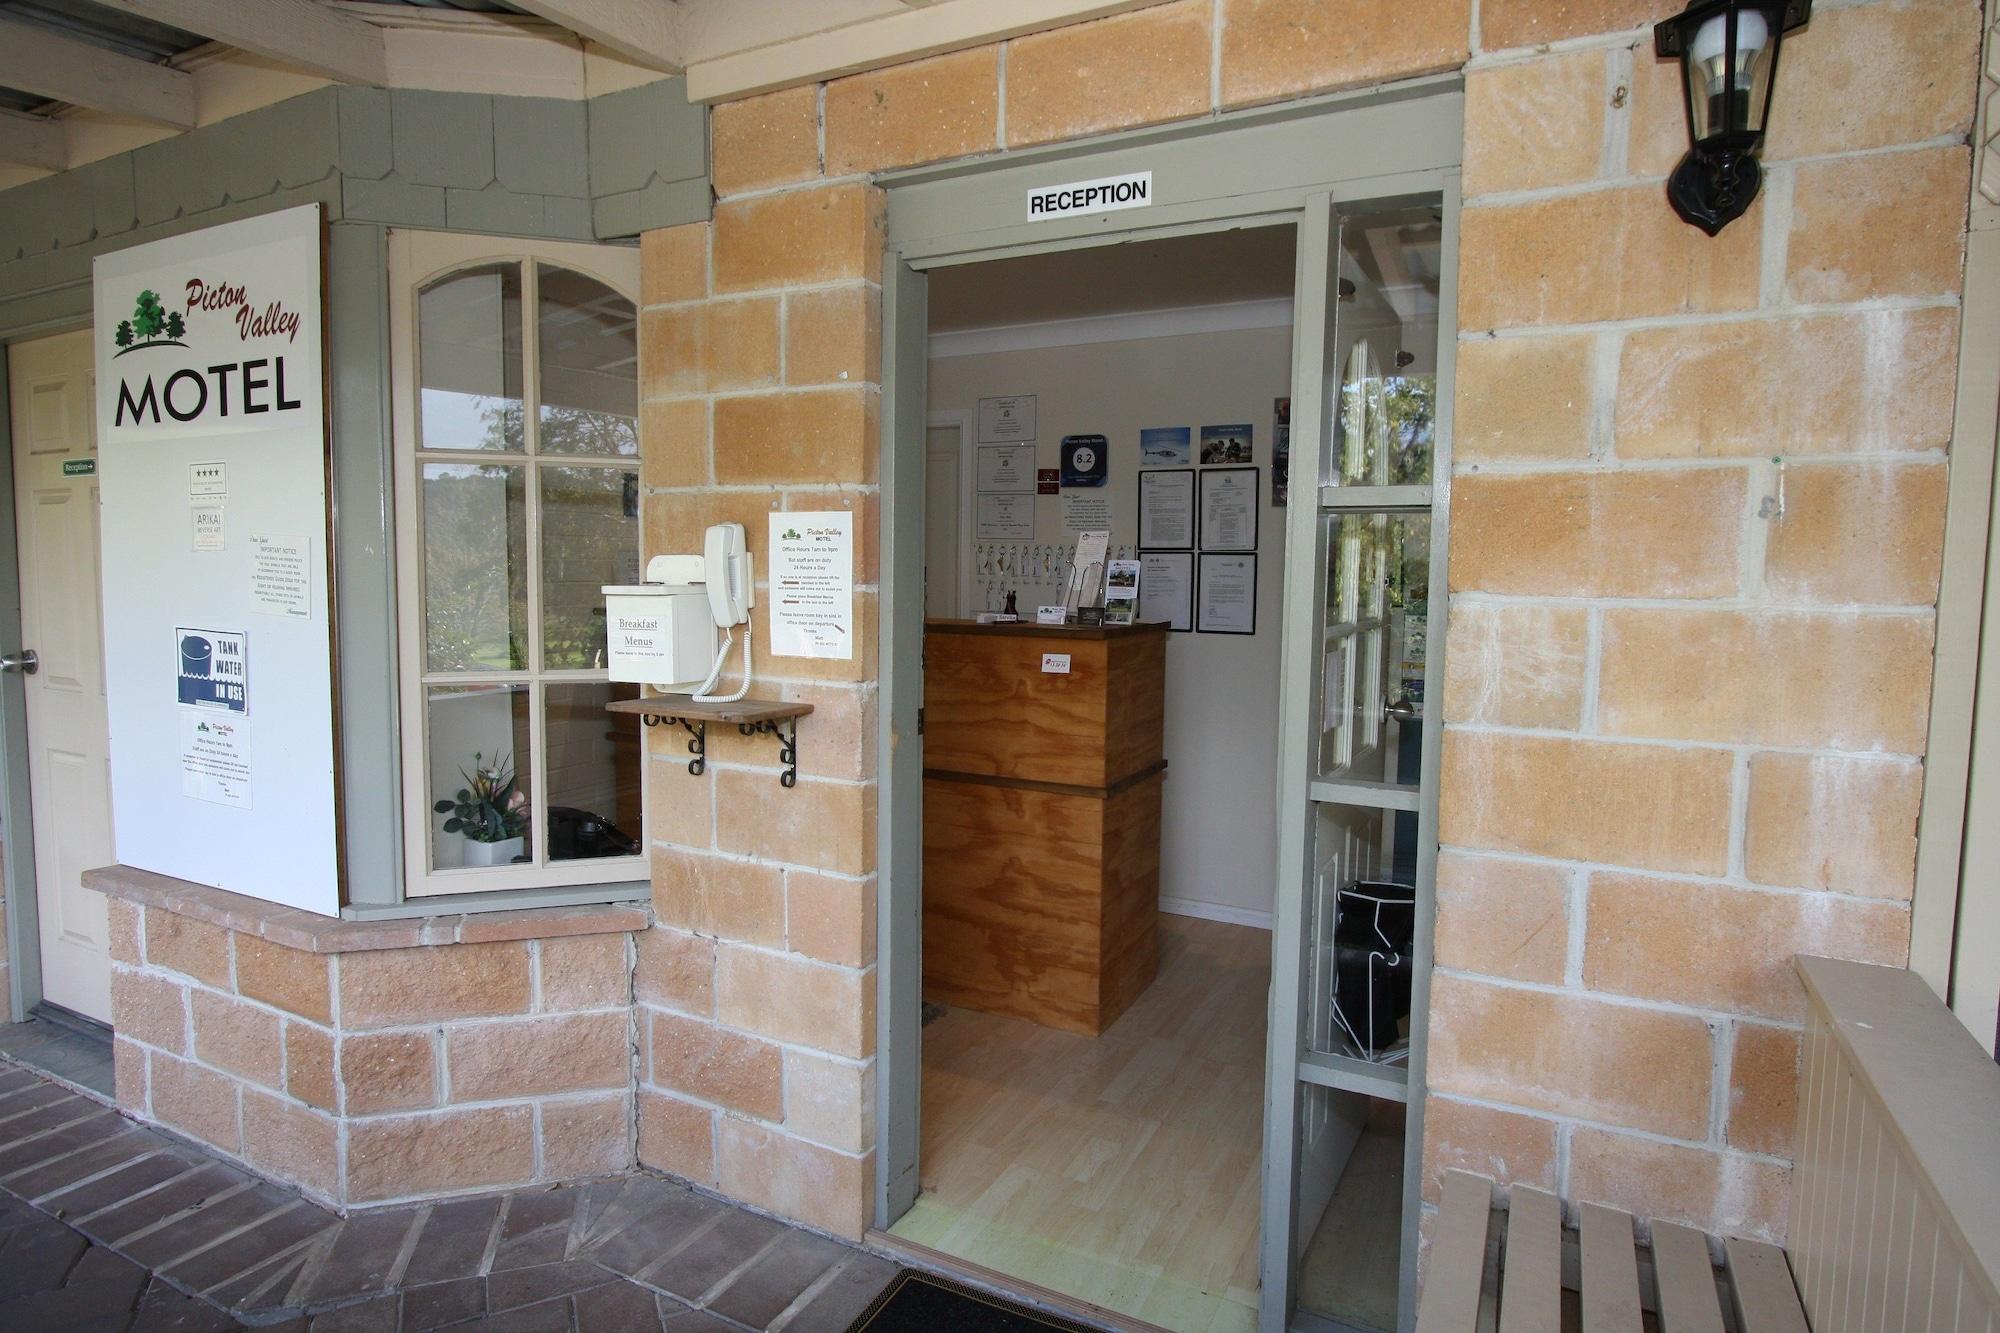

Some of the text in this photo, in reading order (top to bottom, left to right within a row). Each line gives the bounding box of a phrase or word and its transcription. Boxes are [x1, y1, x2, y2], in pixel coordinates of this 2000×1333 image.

[1032, 181, 1146, 214] RECEPTION
[185, 278, 247, 317] Picton
[236, 300, 301, 344] Valley
[115, 356, 301, 427] MOTEL
[1076, 453, 1092, 464] 8.2
[619, 619, 658, 629] Breakfast
[218, 640, 239, 655] TANK
[625, 636, 653, 646] Menus
[216, 659, 242, 676] WATER
[216, 683, 243, 701] IN USE
